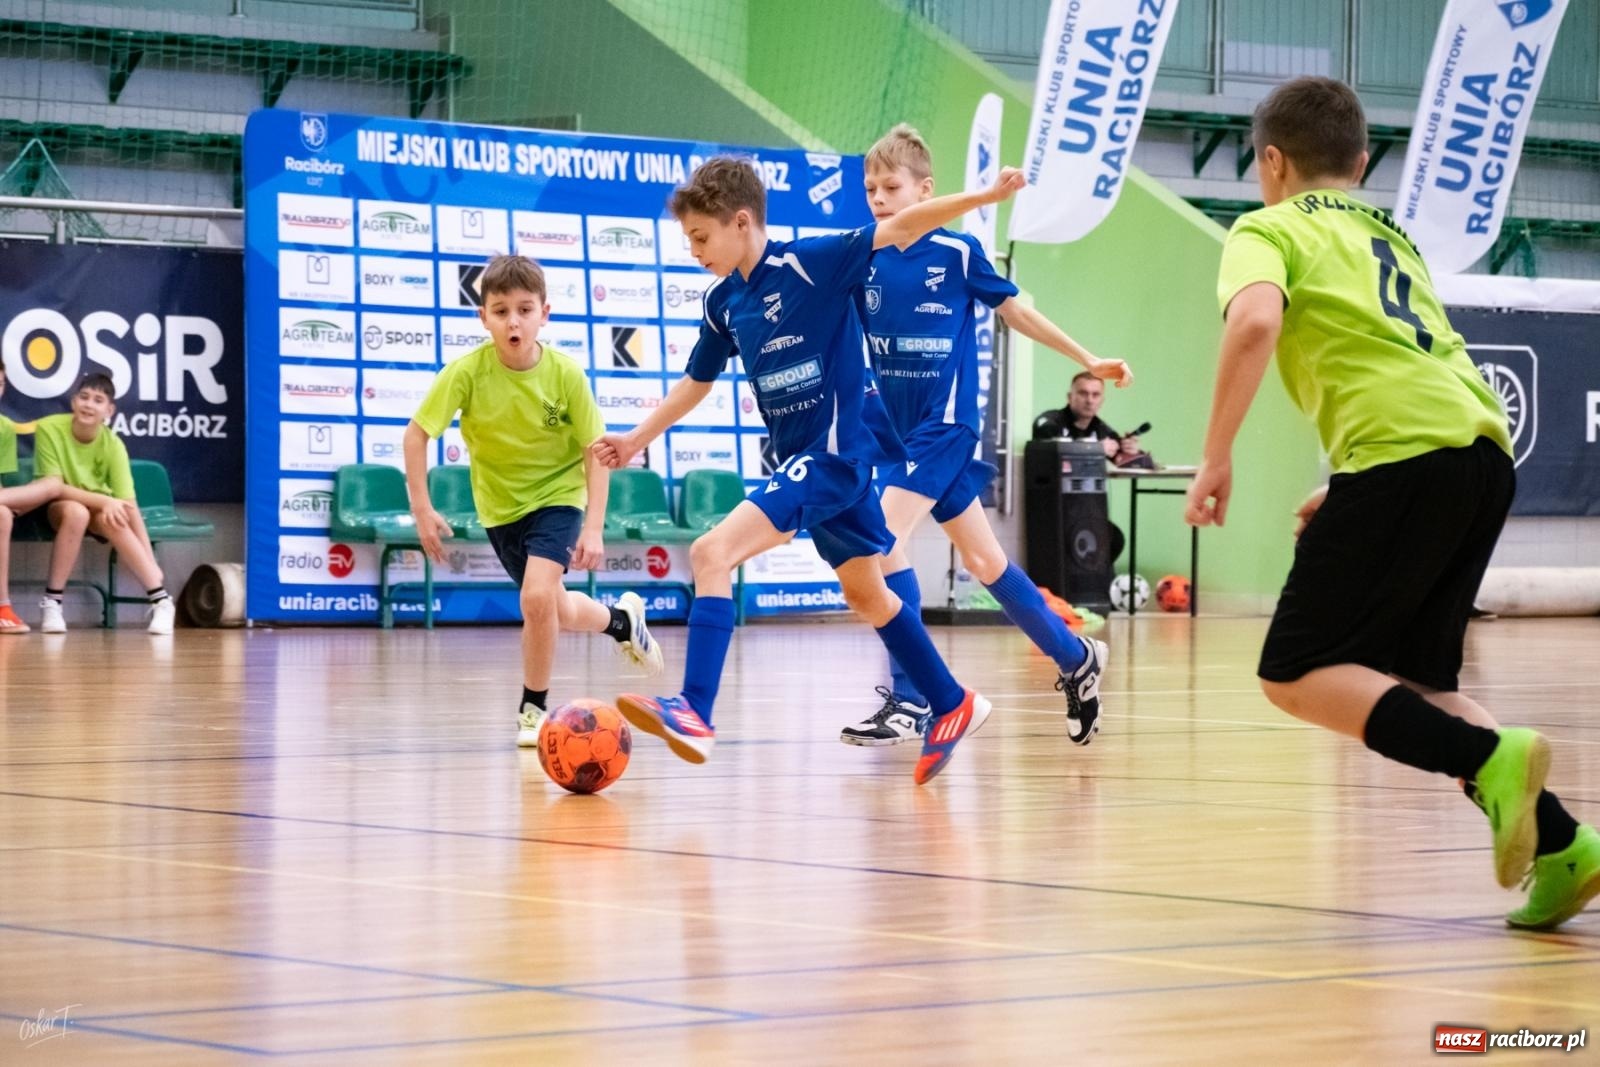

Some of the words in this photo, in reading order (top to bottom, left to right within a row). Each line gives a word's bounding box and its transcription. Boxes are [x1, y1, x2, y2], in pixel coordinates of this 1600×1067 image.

[1056, 0, 1081, 65] SPORTO
[1050, 71, 1064, 113] KLUB
[1057, 26, 1122, 154] UNIA
[1092, 0, 1167, 200] RACIBÓRZ
[1406, 158, 1429, 220] MIEJSKI
[1426, 112, 1441, 153] KLUB
[1434, 24, 1468, 107] SPORTOWY
[1434, 73, 1498, 192] UNIA
[1465, 42, 1541, 234] RACIBÓRZ
[285, 156, 344, 175] Racibórz
[357, 129, 447, 168] MIEJSKI
[452, 138, 511, 173] KLUB
[514, 143, 630, 181] SPORTOWY
[634, 152, 686, 184] UNIA
[1028, 119, 1051, 186] MIEJSKI
[364, 273, 396, 286] BOXY
[1371, 236, 1433, 353] 4
[2, 308, 228, 405] OSiR
[385, 331, 433, 346] SPORT
[103, 406, 228, 438] ACIBÓRZ
[675, 451, 701, 462] BOXY
[281, 552, 323, 570] radio
[606, 554, 642, 571] radio
